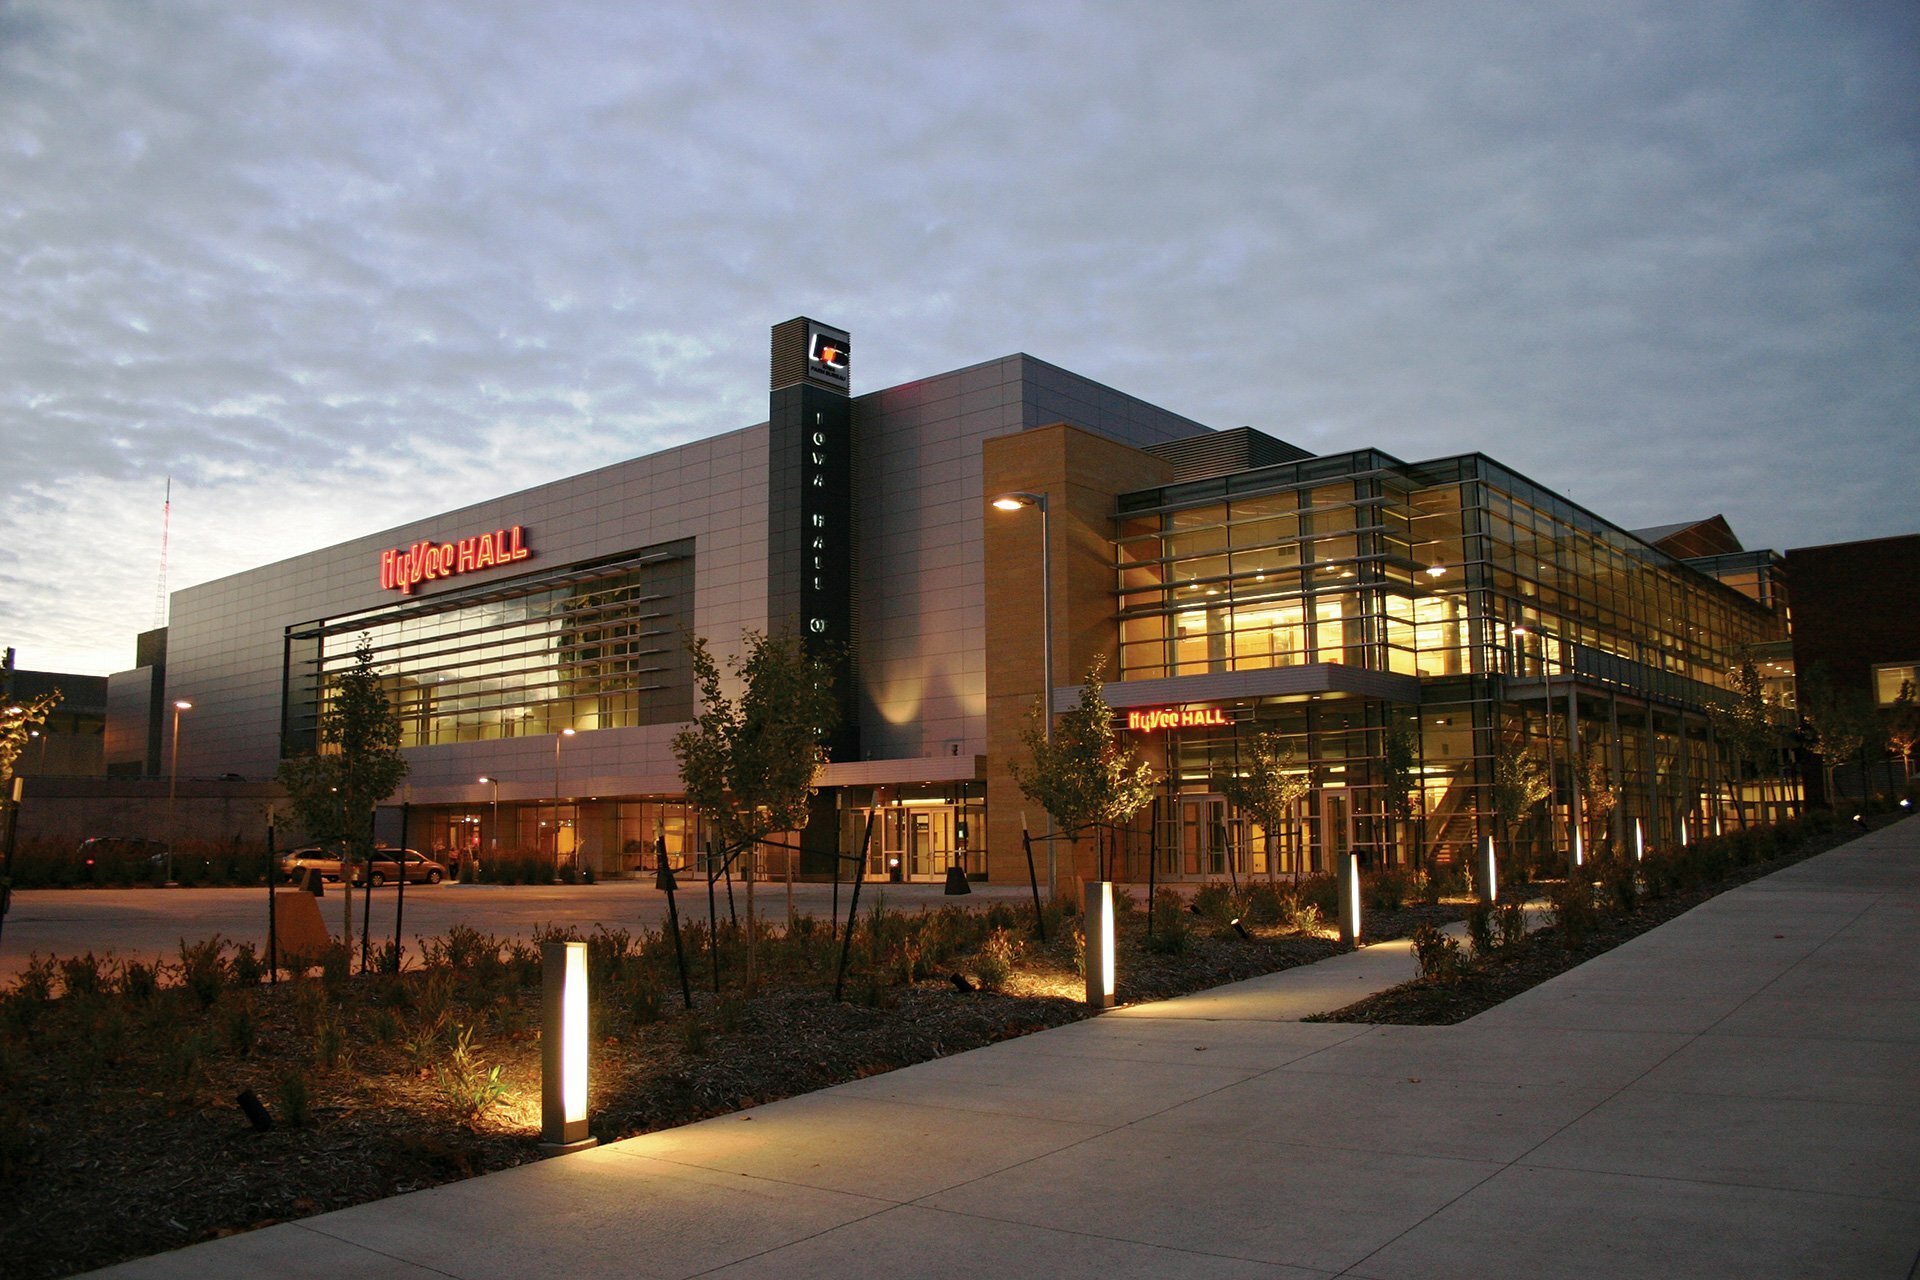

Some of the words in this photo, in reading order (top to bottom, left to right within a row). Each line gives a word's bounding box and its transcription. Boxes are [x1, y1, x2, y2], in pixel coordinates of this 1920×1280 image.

[812, 412, 826, 487] IOWA
[457, 524, 531, 572] HALL
[812, 513, 825, 591] HALL
[1181, 709, 1226, 726] HALL
